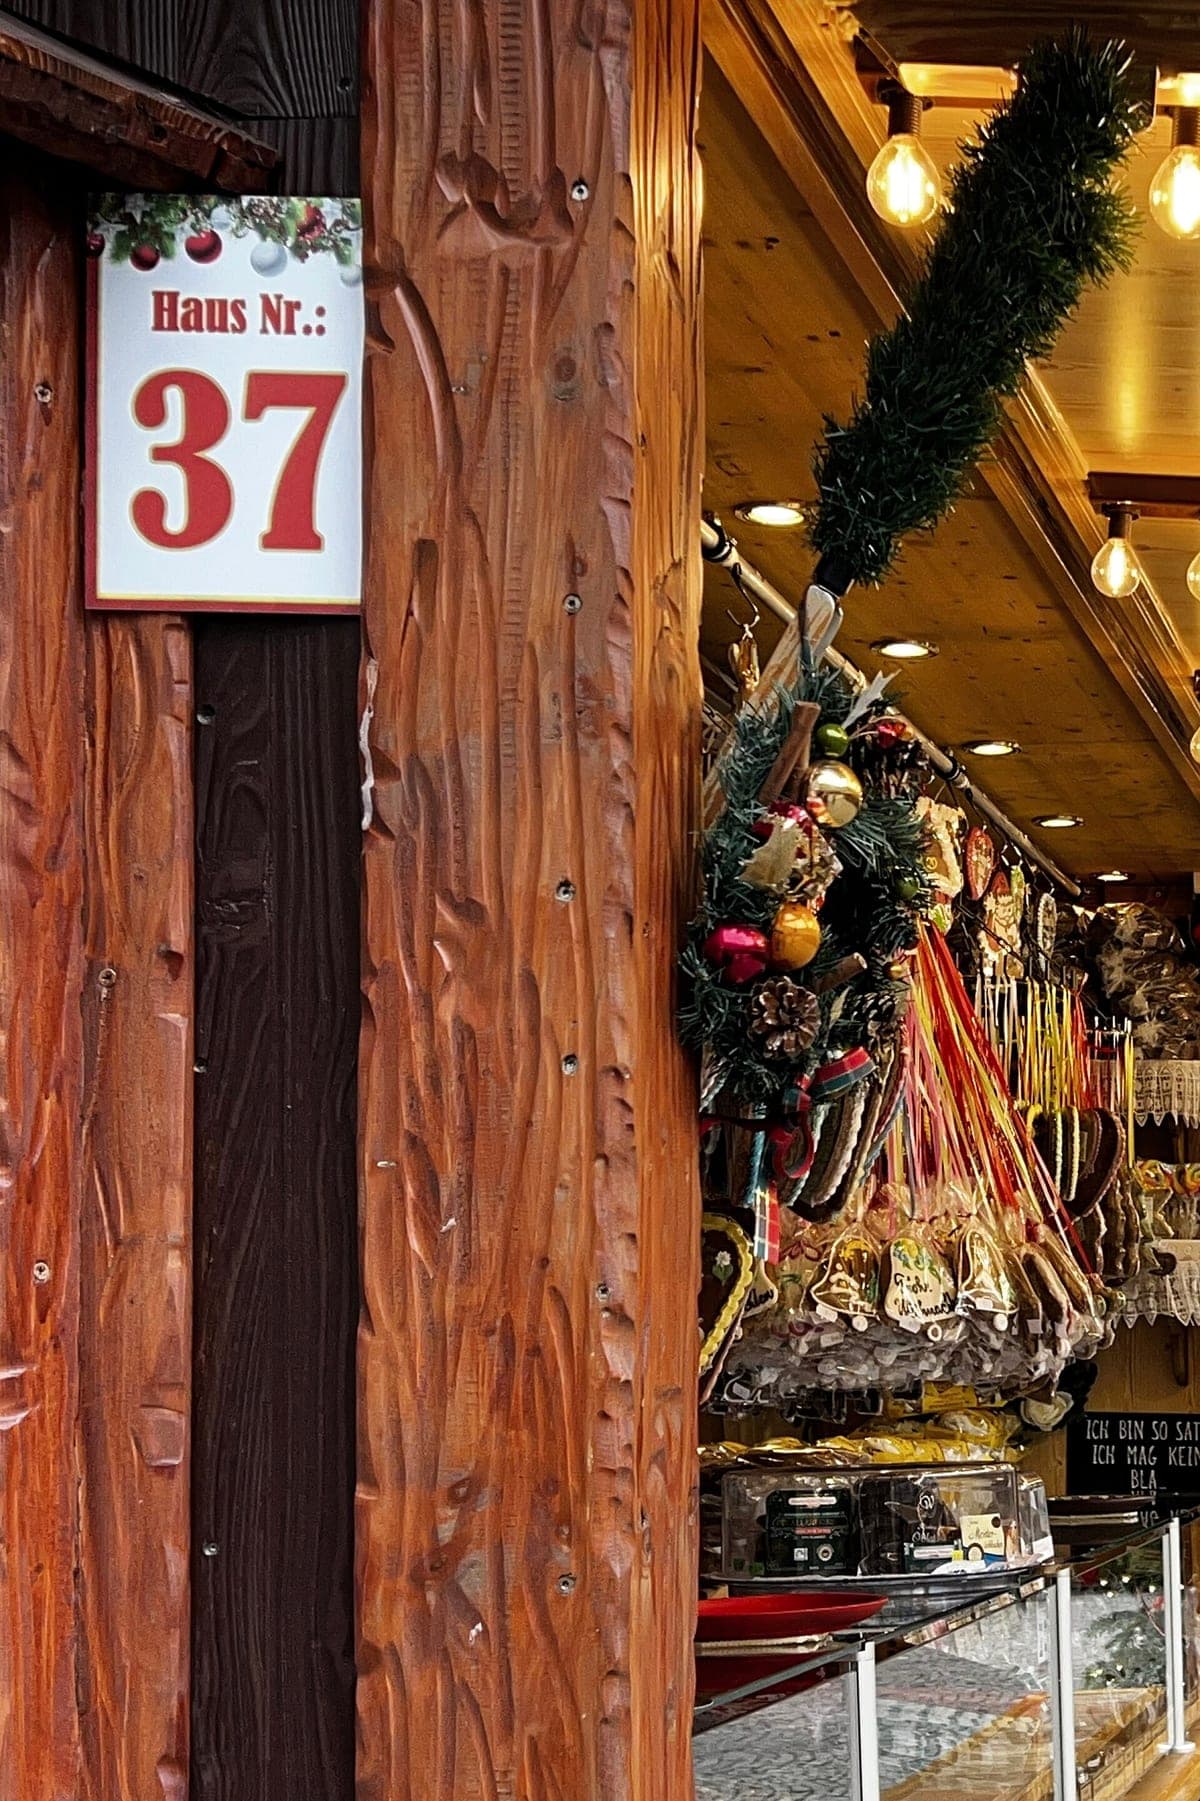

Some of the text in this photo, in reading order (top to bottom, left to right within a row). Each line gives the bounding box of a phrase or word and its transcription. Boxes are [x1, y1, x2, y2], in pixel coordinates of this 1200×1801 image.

[151, 290, 327, 336] Haus Nr.:
[129, 367, 349, 553] 37
[1086, 1419, 1109, 1439] ICH
[1119, 1420, 1144, 1440] BIN
[1151, 1421, 1168, 1441] SO
[1092, 1444, 1115, 1465] ICH
[1127, 1445, 1158, 1466] MAG
